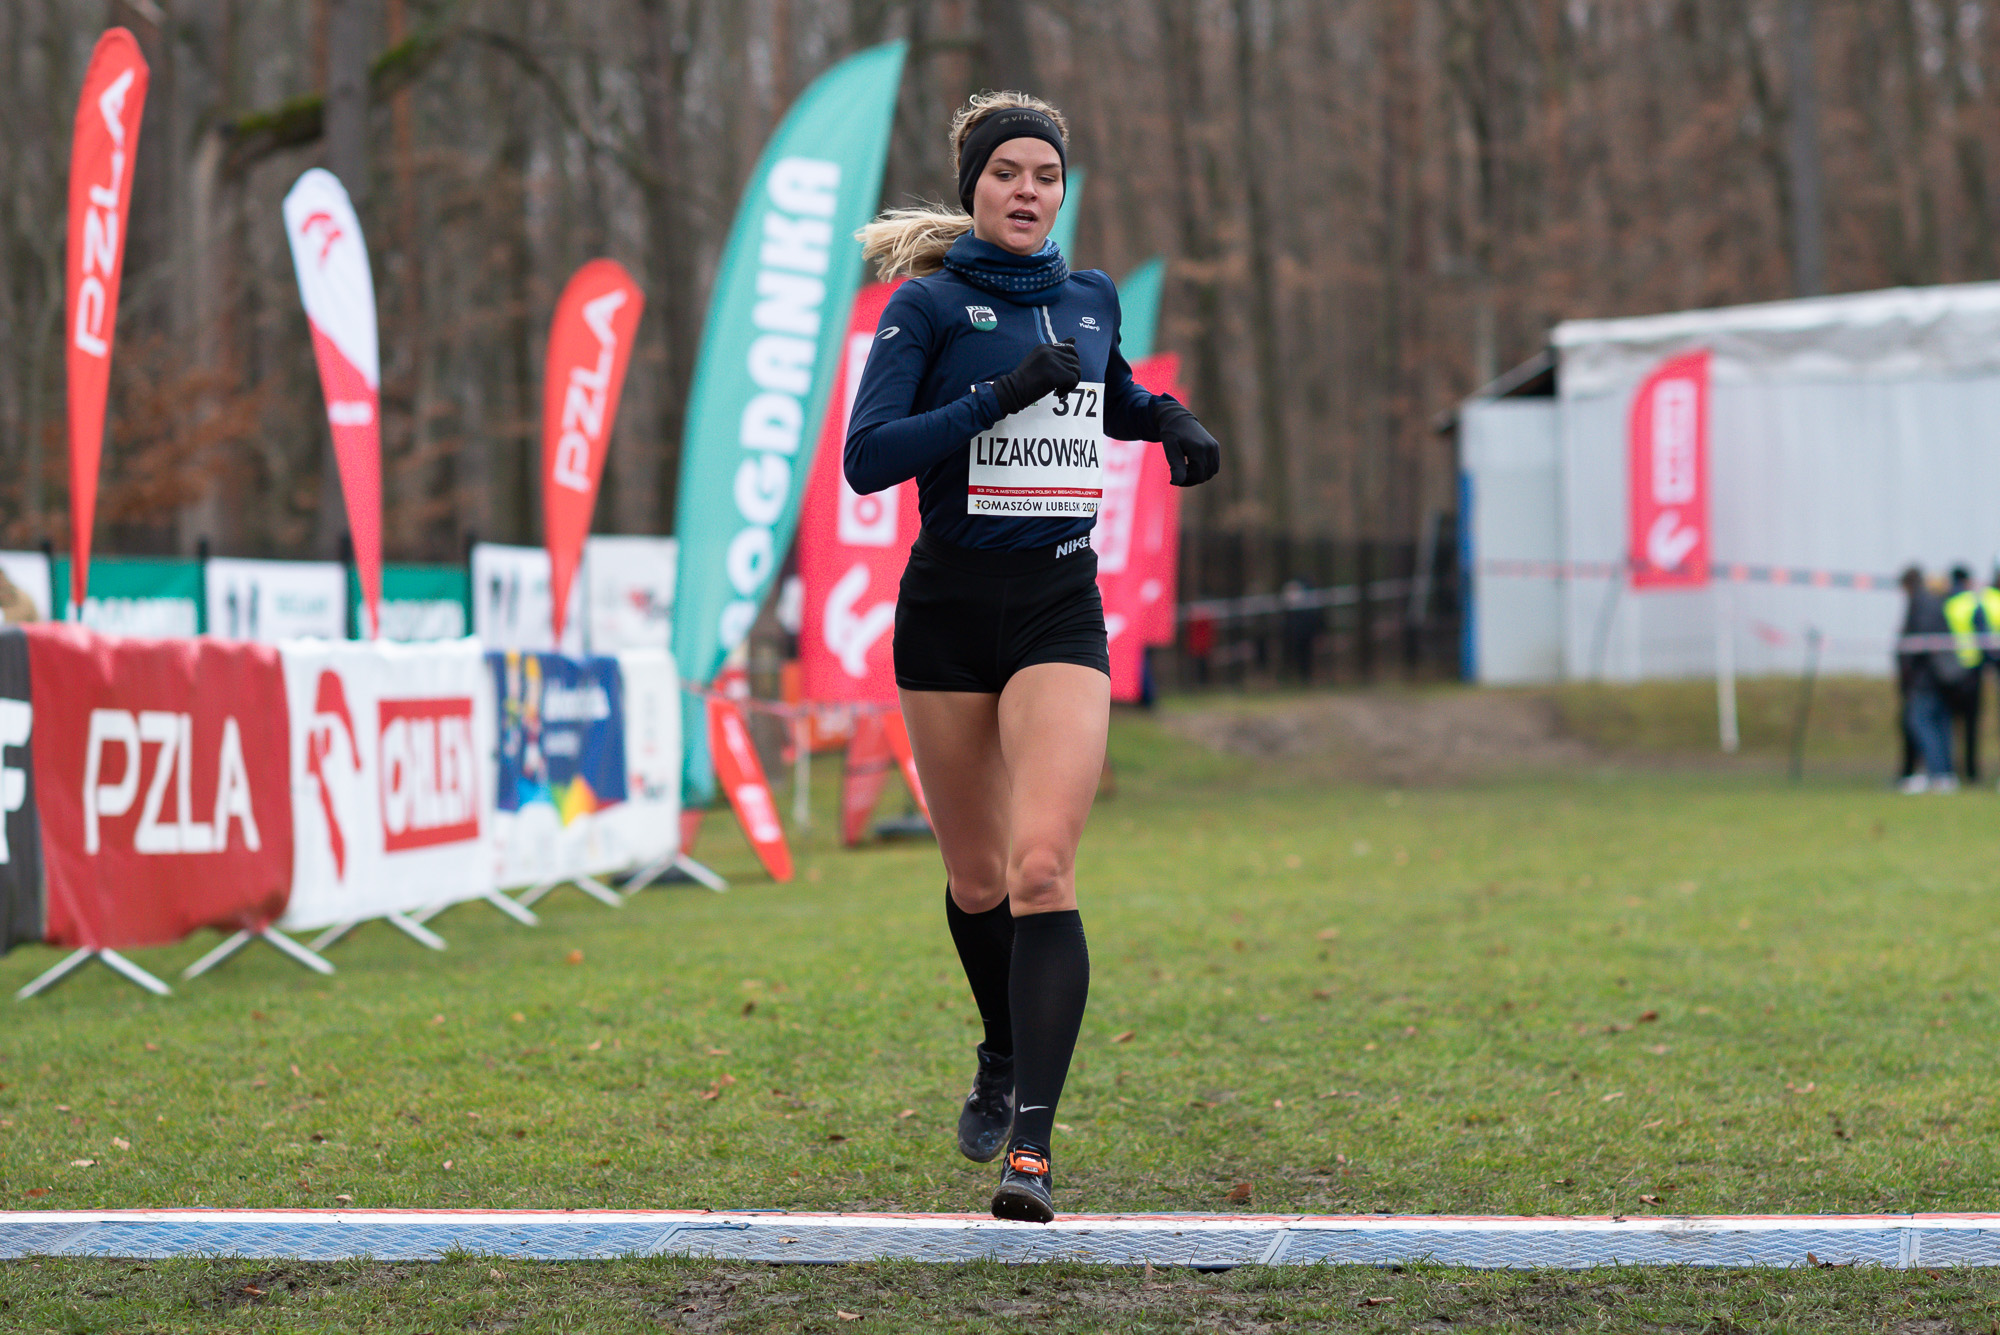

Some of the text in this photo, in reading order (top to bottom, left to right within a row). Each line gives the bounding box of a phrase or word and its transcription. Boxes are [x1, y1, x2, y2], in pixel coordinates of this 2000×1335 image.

[75, 69, 135, 358] PZLA
[552, 287, 629, 494] PZLA
[976, 436, 1099, 468] LIZAKOWSKA
[975, 499, 1043, 512] TOMASZÓW
[1082, 502, 1098, 512] 2021
[1055, 536, 1089, 559] NIKE
[83, 708, 261, 856] PZLA
